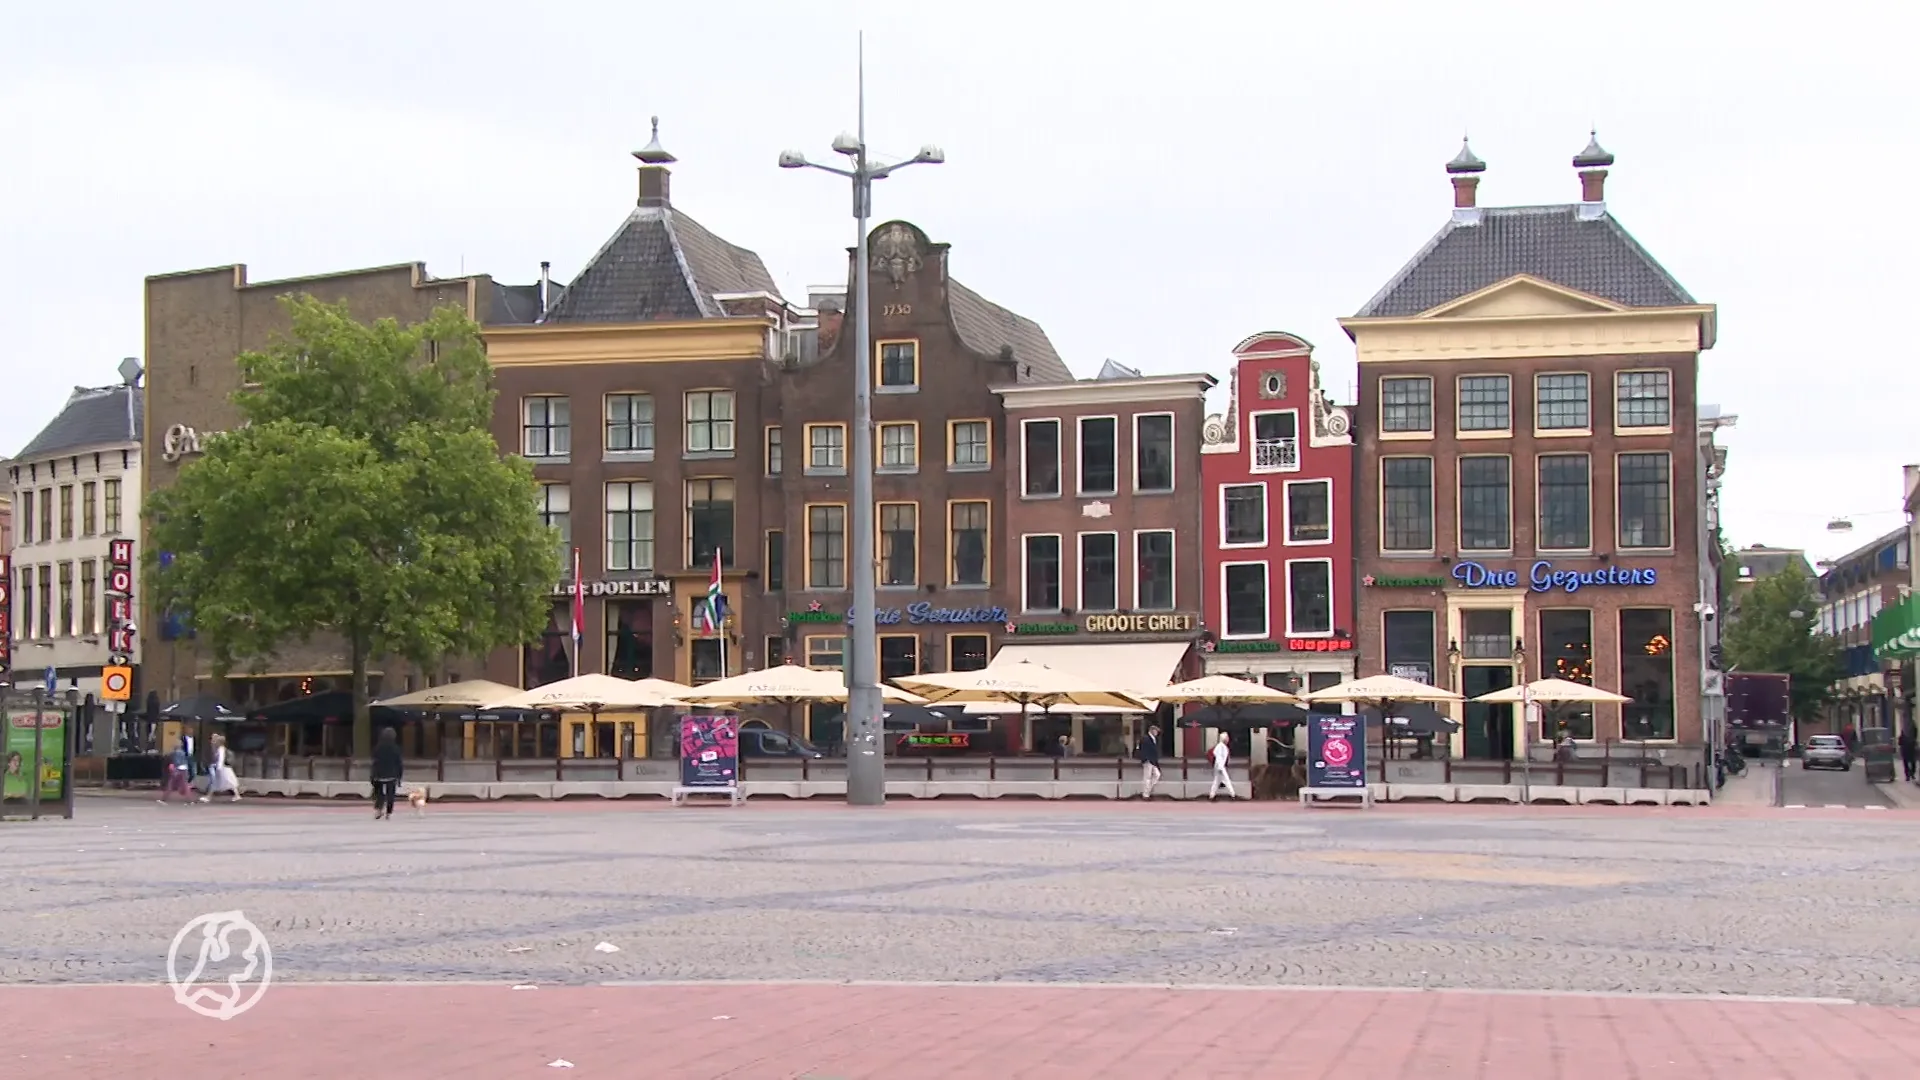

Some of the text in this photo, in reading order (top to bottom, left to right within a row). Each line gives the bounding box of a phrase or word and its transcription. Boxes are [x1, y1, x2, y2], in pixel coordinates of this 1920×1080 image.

[1452, 560, 1657, 593] Drie Gezusters
[592, 580, 671, 596] DOELEN
[906, 601, 1009, 625] Gezusters
[1085, 614, 1191, 632] GROOTE GRIET
